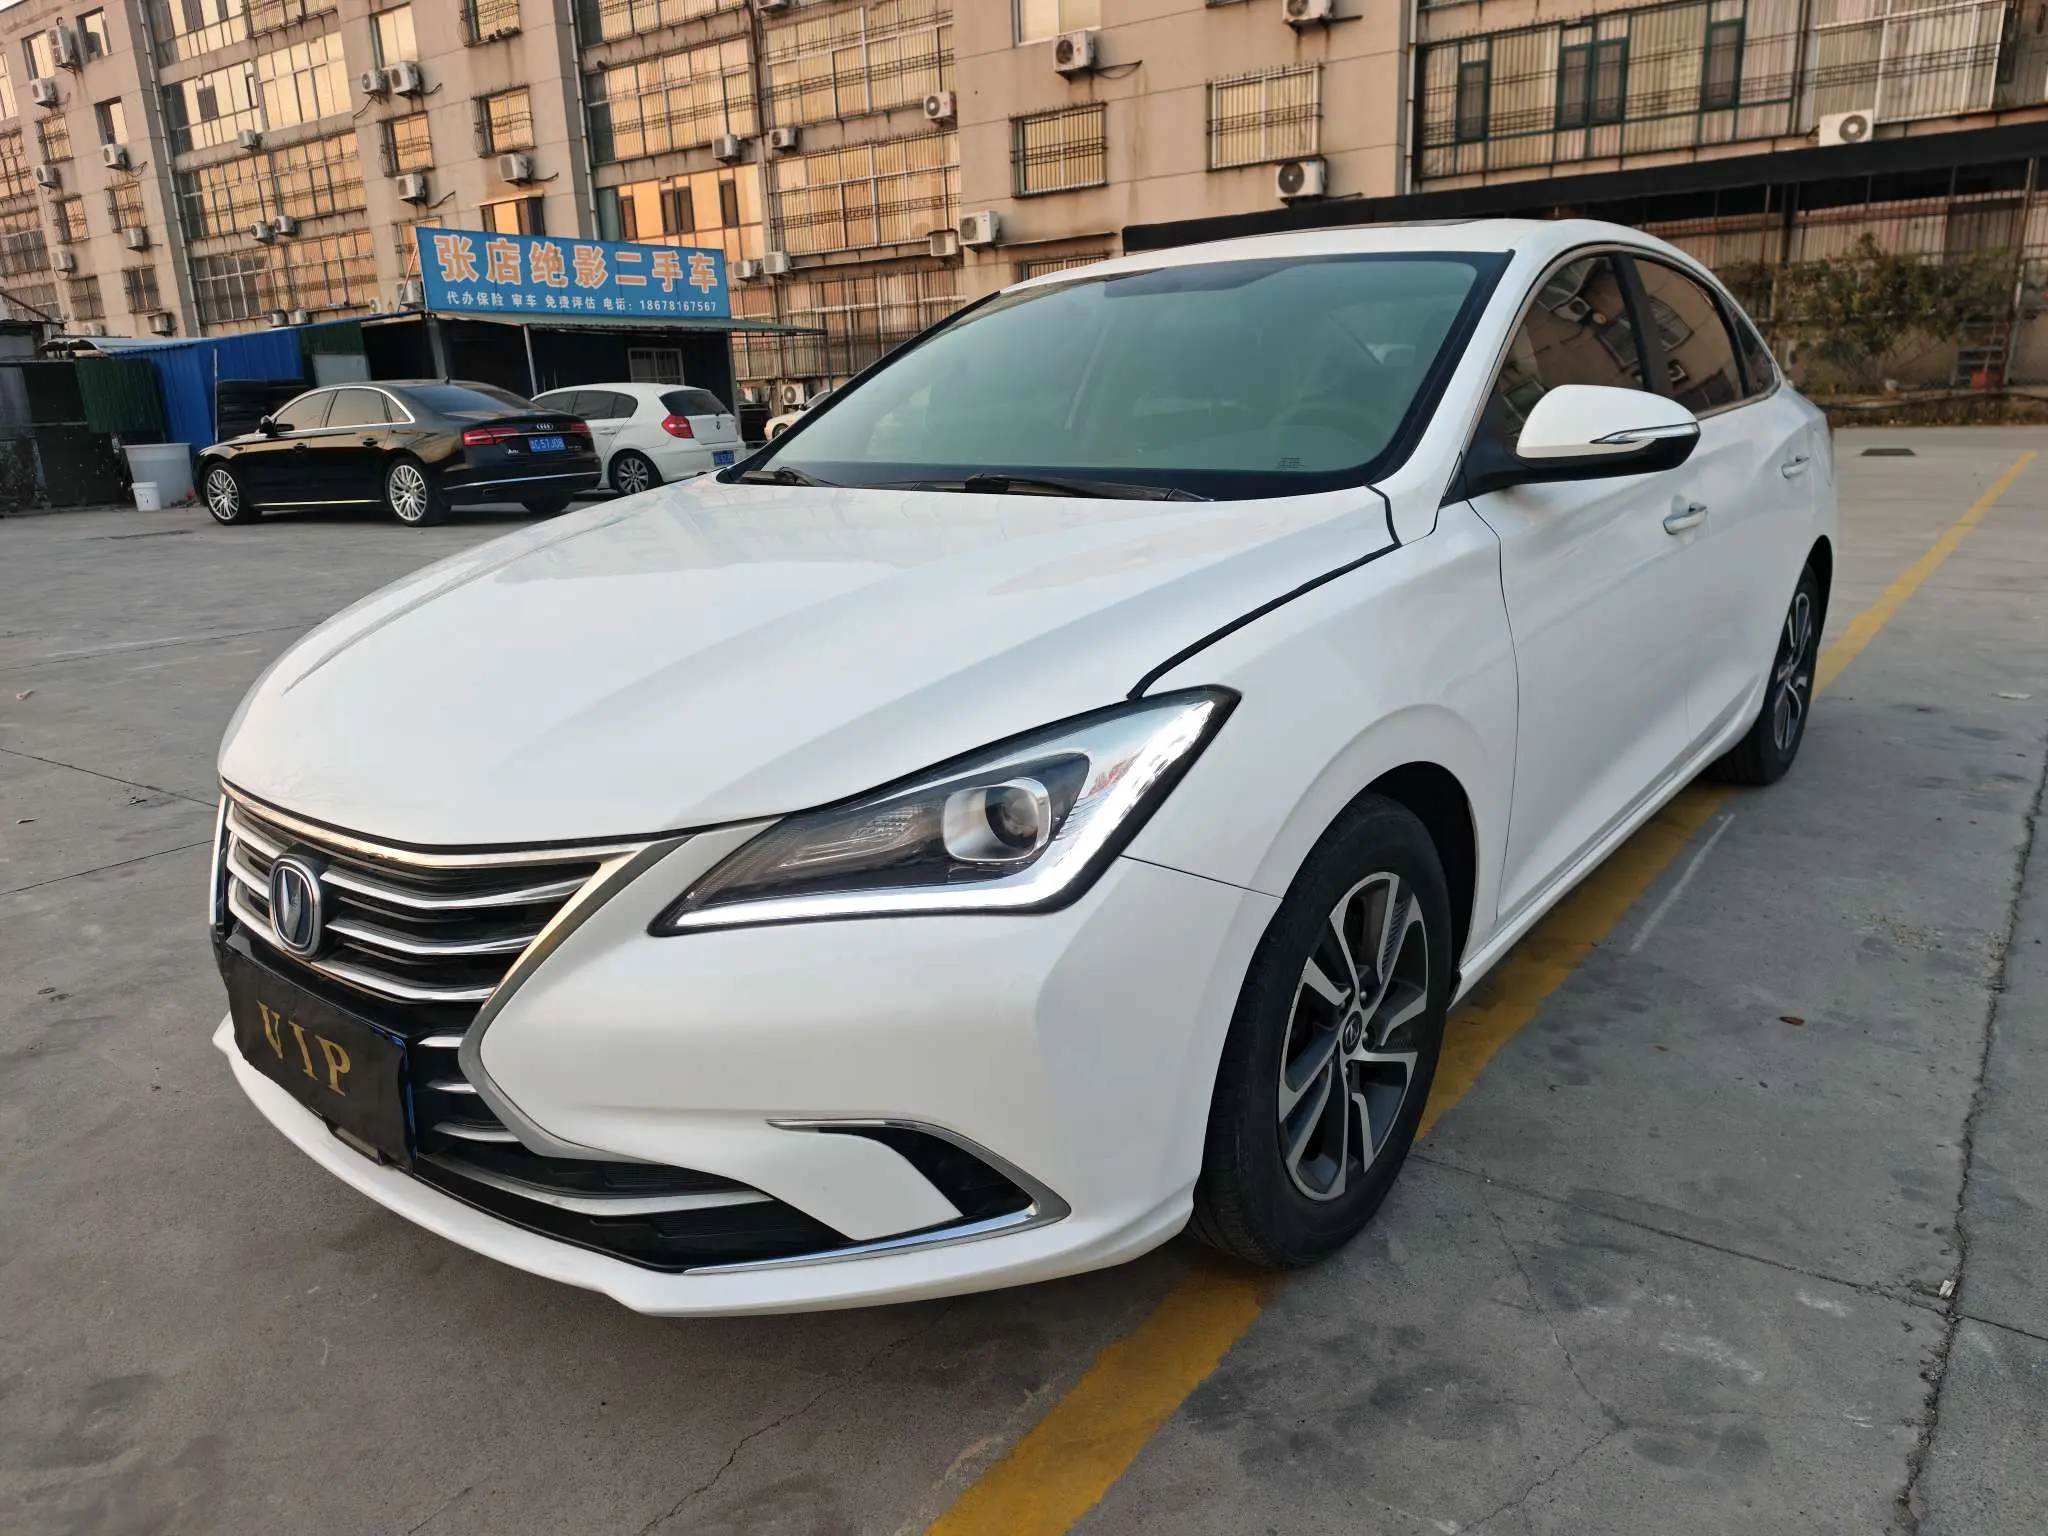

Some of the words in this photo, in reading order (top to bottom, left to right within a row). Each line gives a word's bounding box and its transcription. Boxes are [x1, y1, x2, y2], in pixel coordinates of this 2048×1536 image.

[433, 234, 718, 294] 张店绝影二手车
[447, 291, 504, 307] 代办保险
[511, 293, 537, 307] 审车
[545, 294, 596, 309] 免费评估
[640, 299, 717, 312] 18678167567
[256, 1000, 351, 1097] VIP
